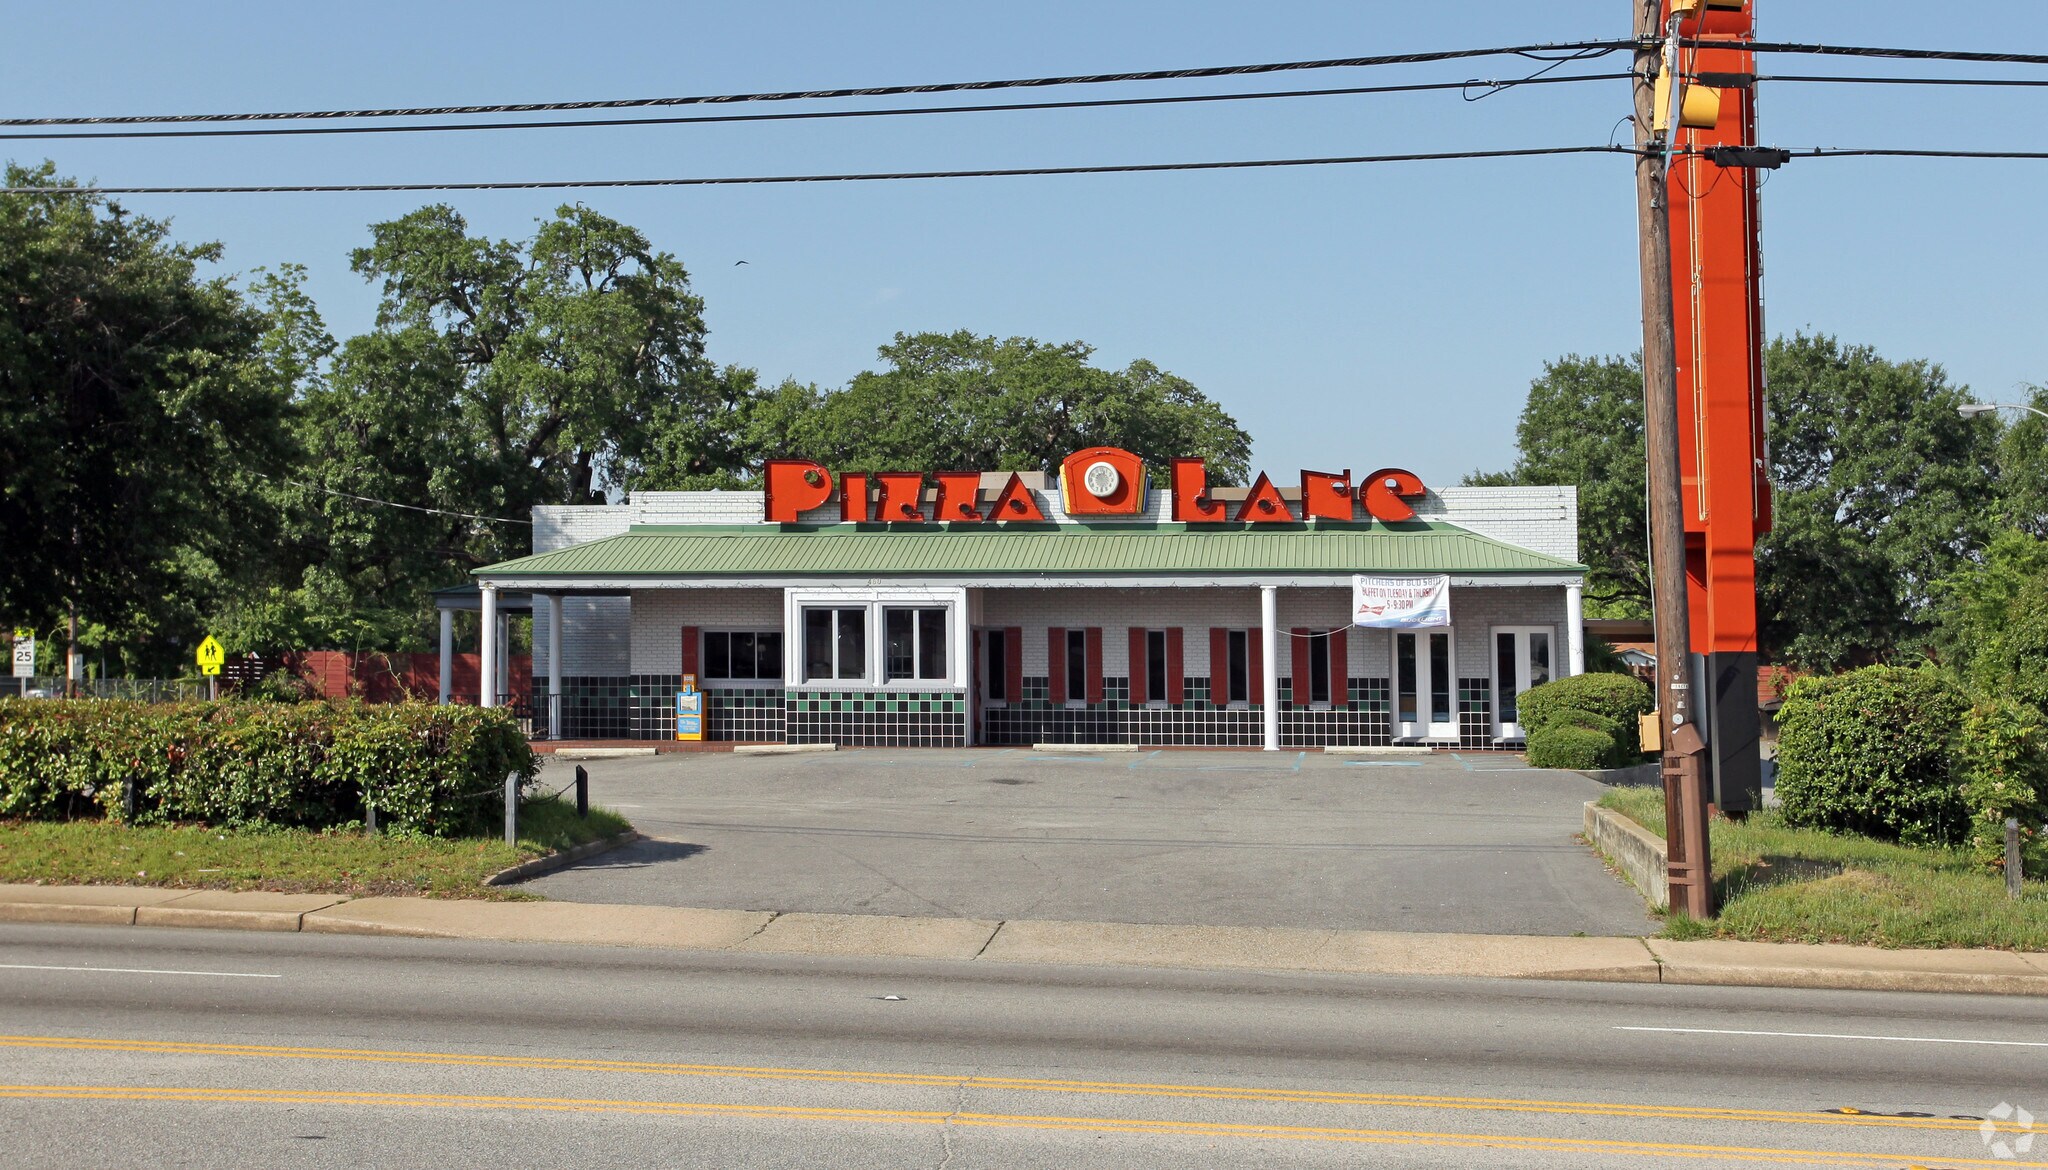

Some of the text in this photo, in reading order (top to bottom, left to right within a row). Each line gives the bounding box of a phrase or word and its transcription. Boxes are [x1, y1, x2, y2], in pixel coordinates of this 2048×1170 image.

[764, 459, 1046, 522] PIZZA
[1393, 600, 1405, 610] 9:30
[1406, 600, 1413, 609] PM
[16, 651, 32, 662] 25
